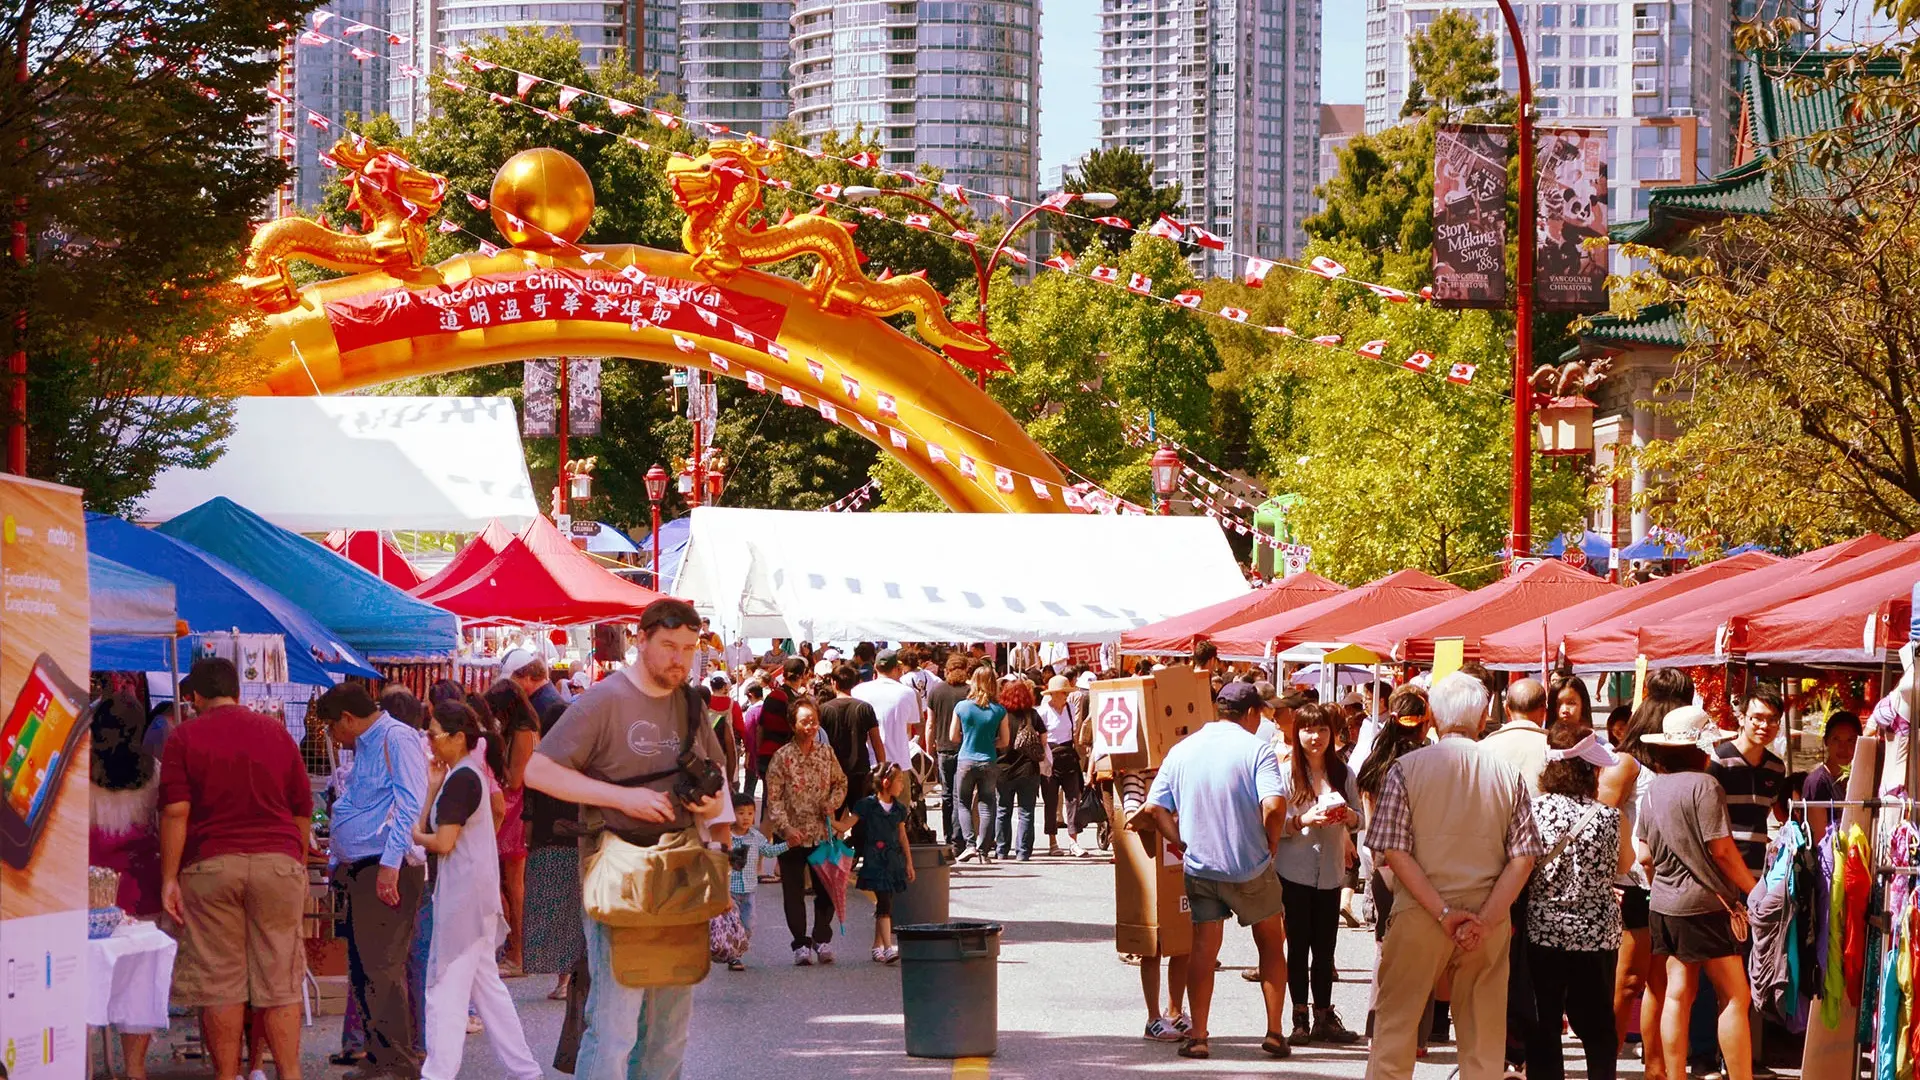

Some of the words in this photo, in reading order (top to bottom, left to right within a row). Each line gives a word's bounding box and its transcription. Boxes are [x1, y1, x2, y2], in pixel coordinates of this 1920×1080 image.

[1437, 222, 1469, 240] Story
[1447, 230, 1497, 254] Making
[1460, 246, 1490, 263] Since
[1476, 255, 1500, 272] 1885
[1549, 275, 1592, 283] VANCOUVER
[1549, 283, 1593, 292] CHINATOWN
[381, 291, 411, 309] TD
[1563, 552, 1585, 564] STOP
